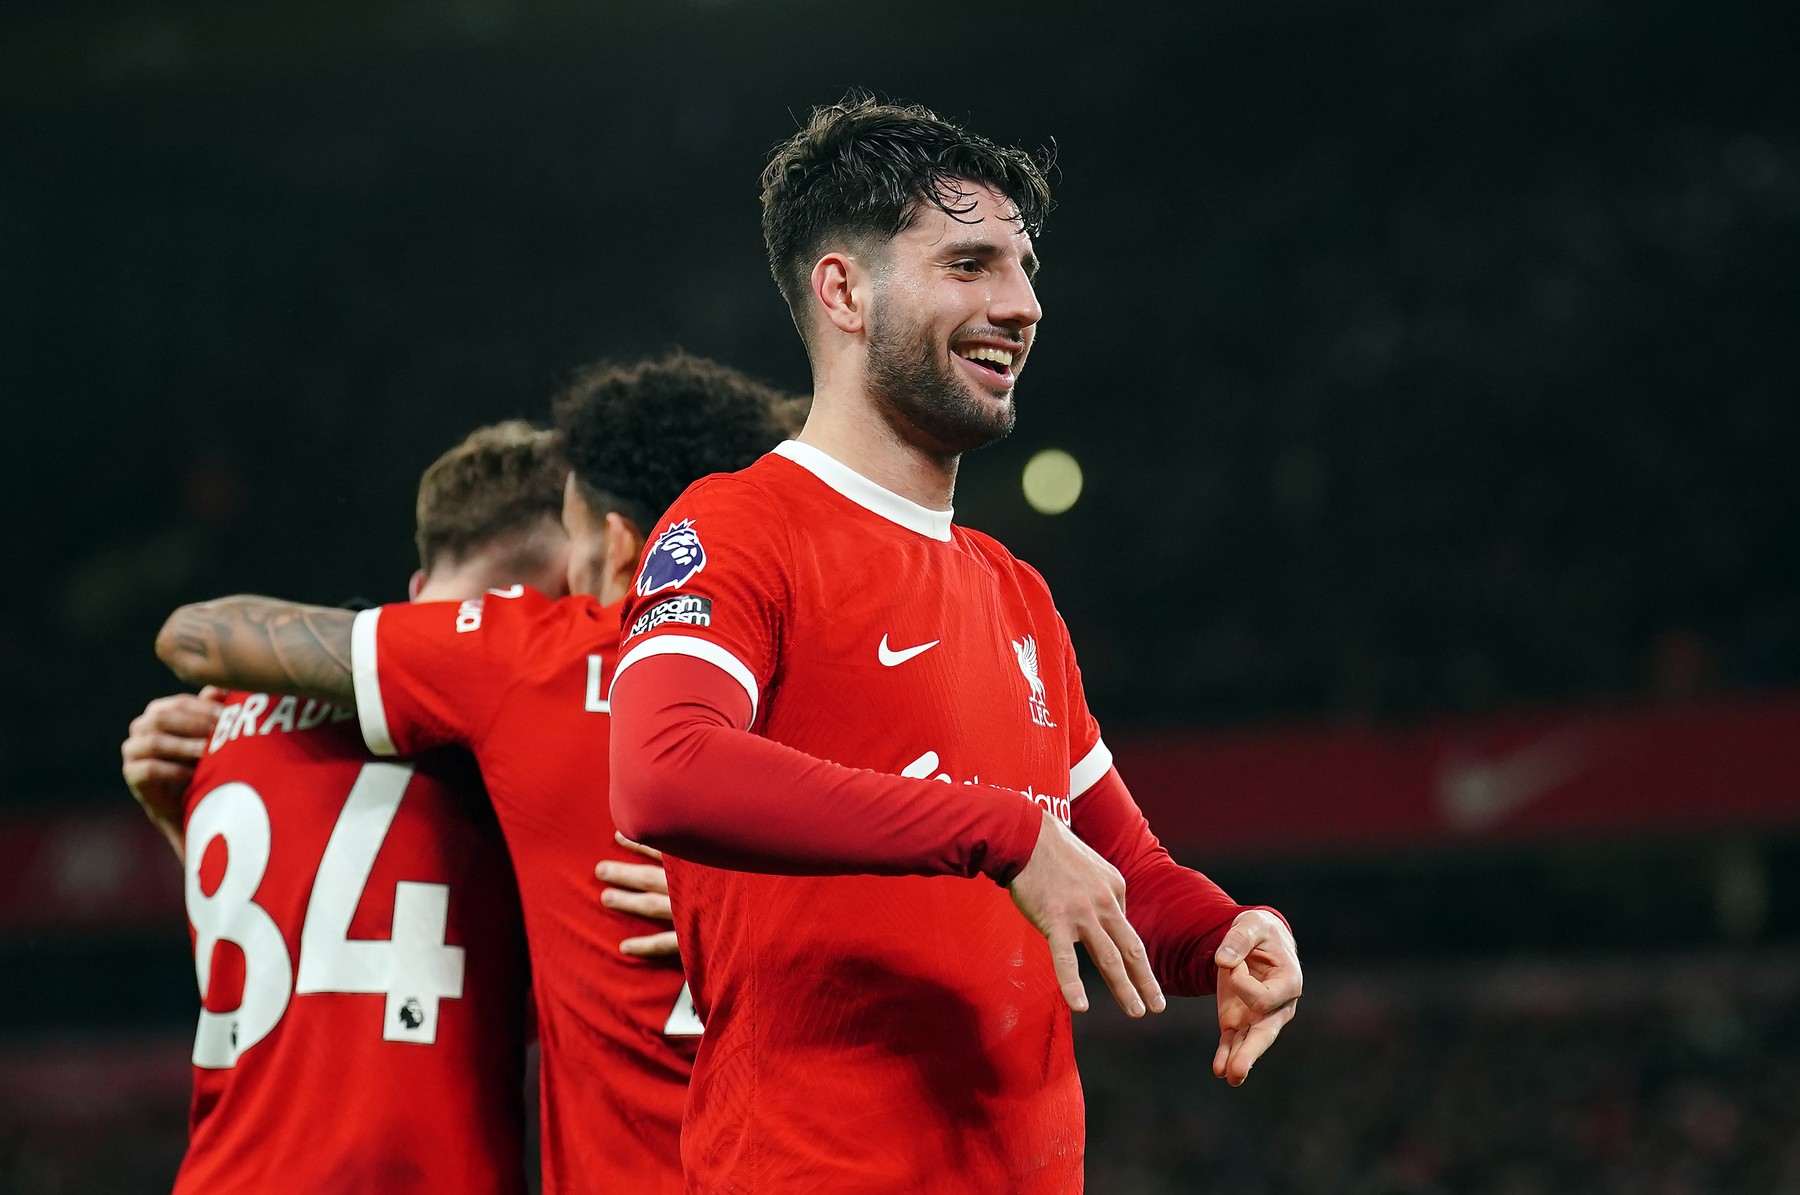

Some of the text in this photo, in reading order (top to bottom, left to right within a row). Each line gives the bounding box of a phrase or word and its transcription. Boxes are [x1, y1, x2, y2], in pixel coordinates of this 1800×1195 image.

[651, 598, 702, 620] room
[648, 611, 711, 631] racism
[185, 762, 465, 1069] 84
